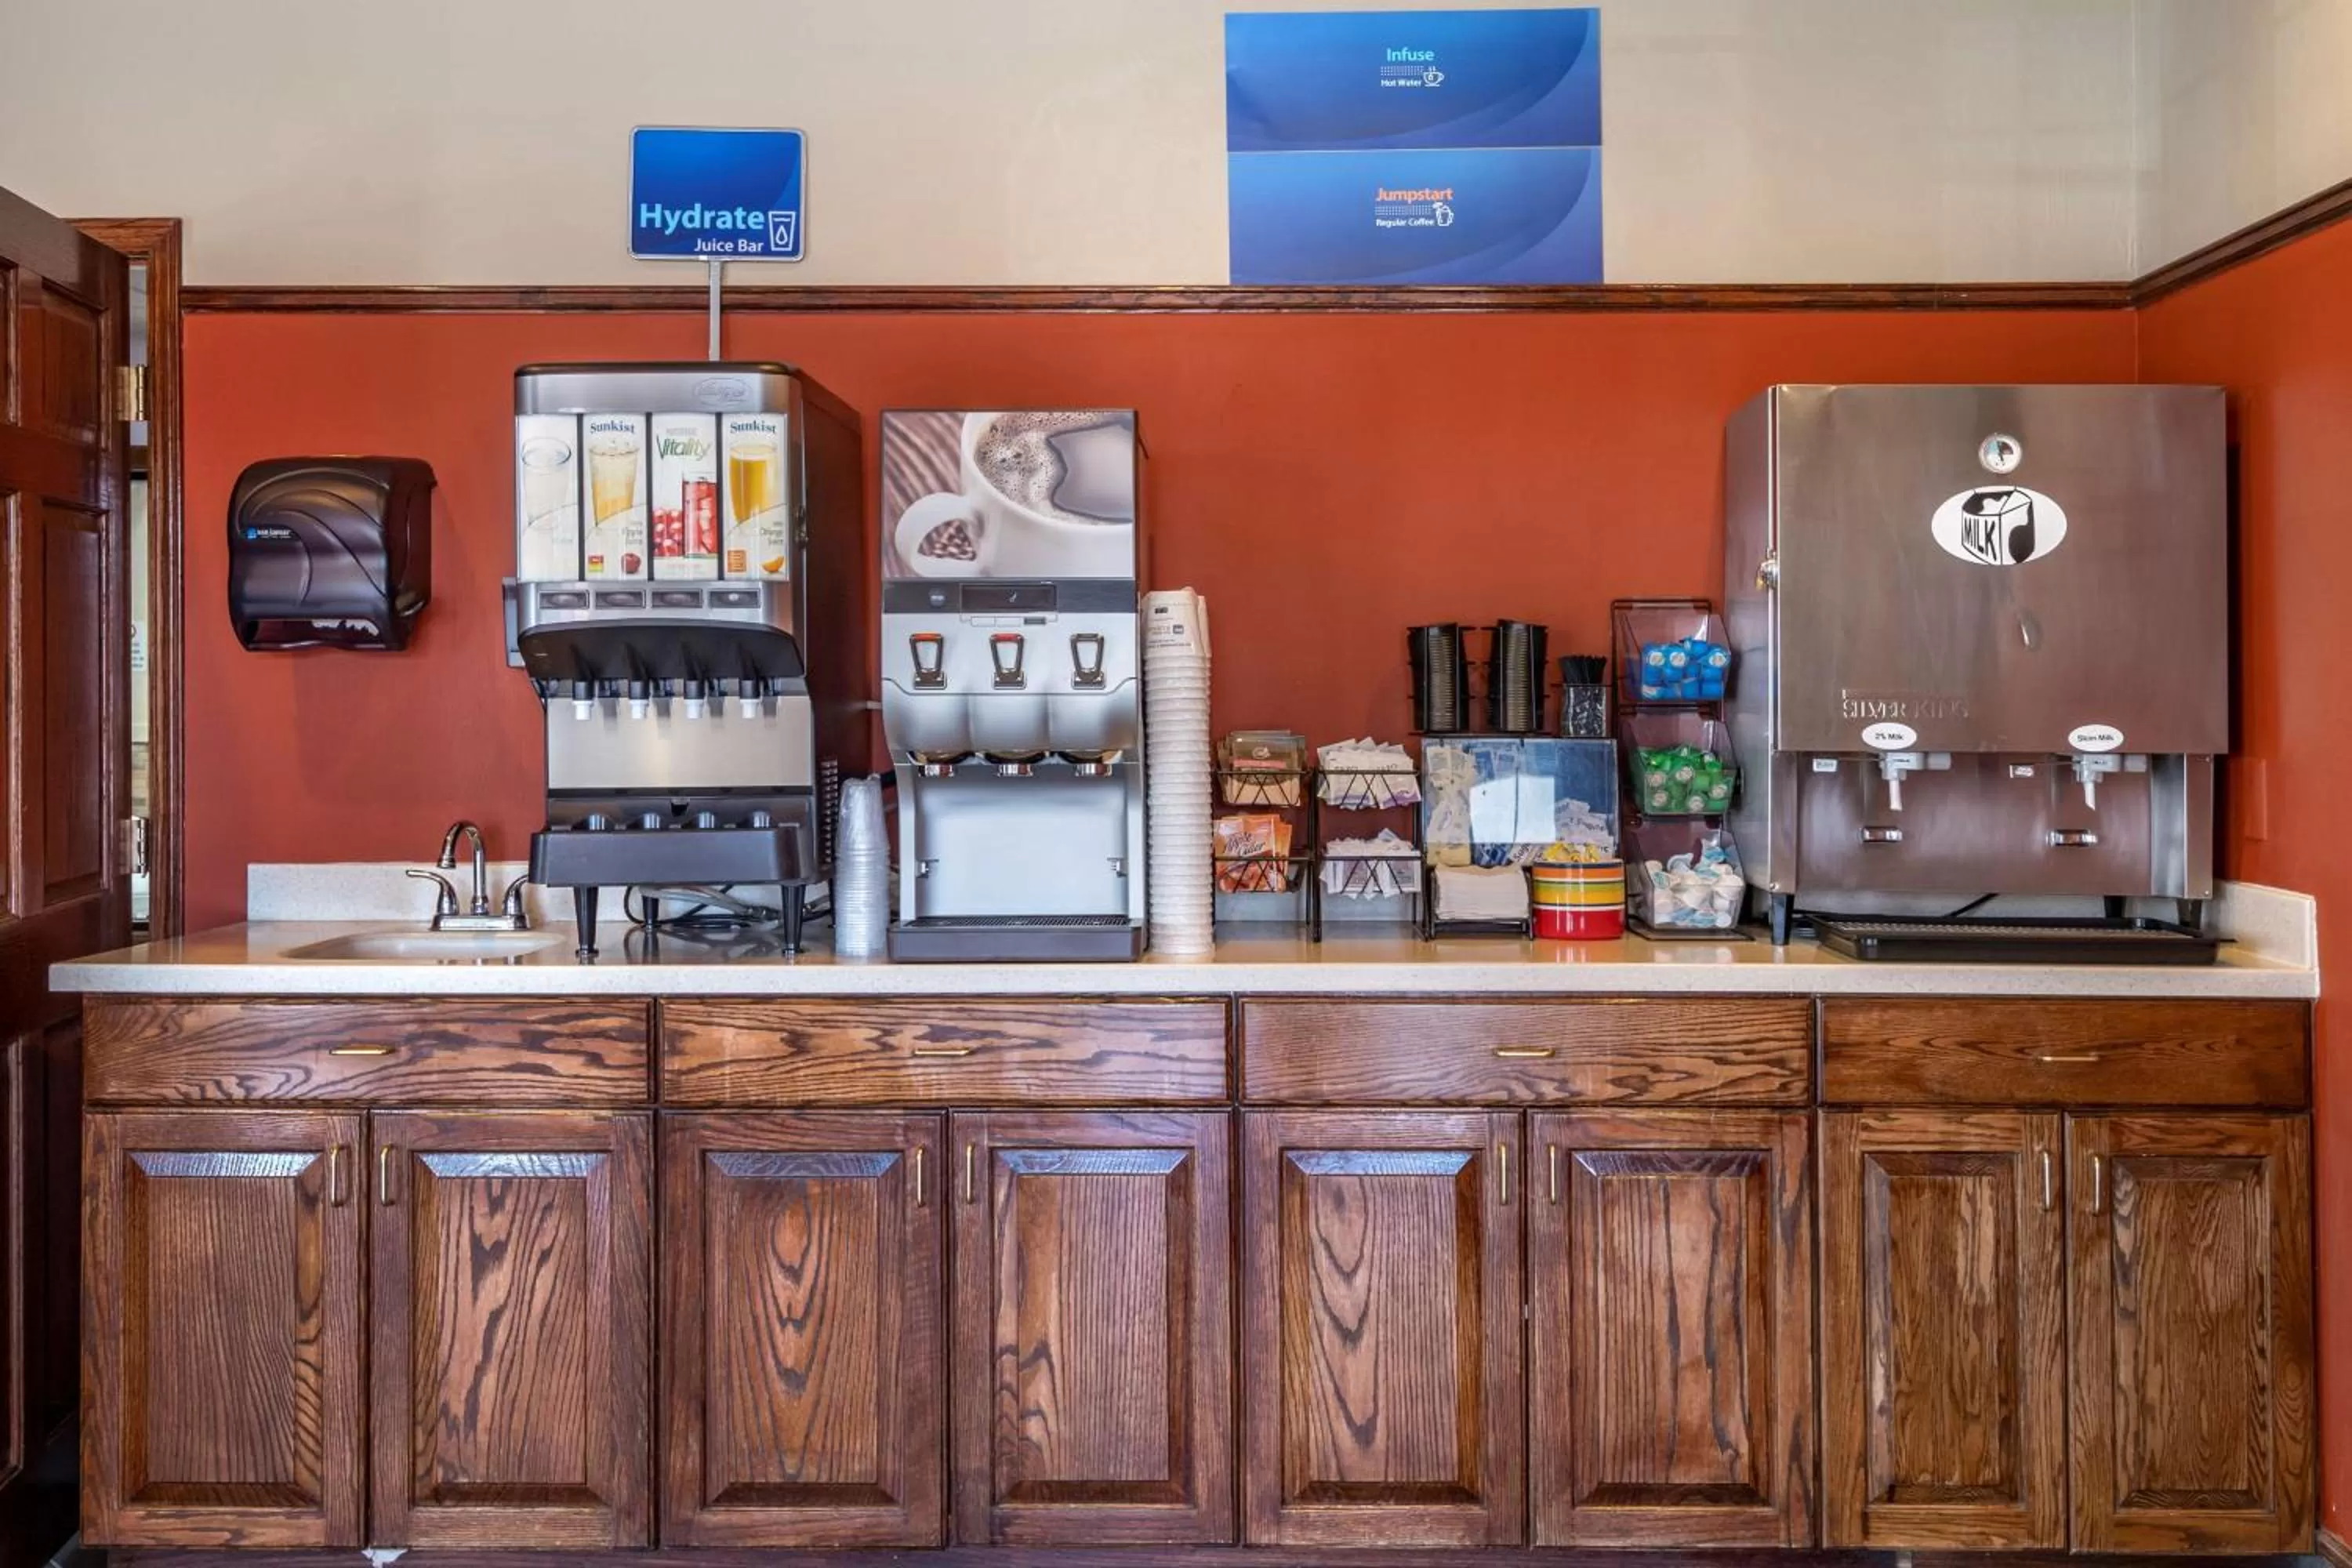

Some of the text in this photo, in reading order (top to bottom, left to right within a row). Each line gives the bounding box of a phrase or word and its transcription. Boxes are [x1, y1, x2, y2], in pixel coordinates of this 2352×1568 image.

[1386, 47, 1435, 62] Infuse
[1376, 188, 1453, 204] Jumpstart
[639, 203, 765, 235] Hydrate
[694, 238, 764, 252] Juice Bar
[590, 419, 634, 434] Sunkist
[730, 419, 776, 434] Sunkist
[656, 434, 712, 461] Vitality
[1964, 517, 1997, 562] MILK
